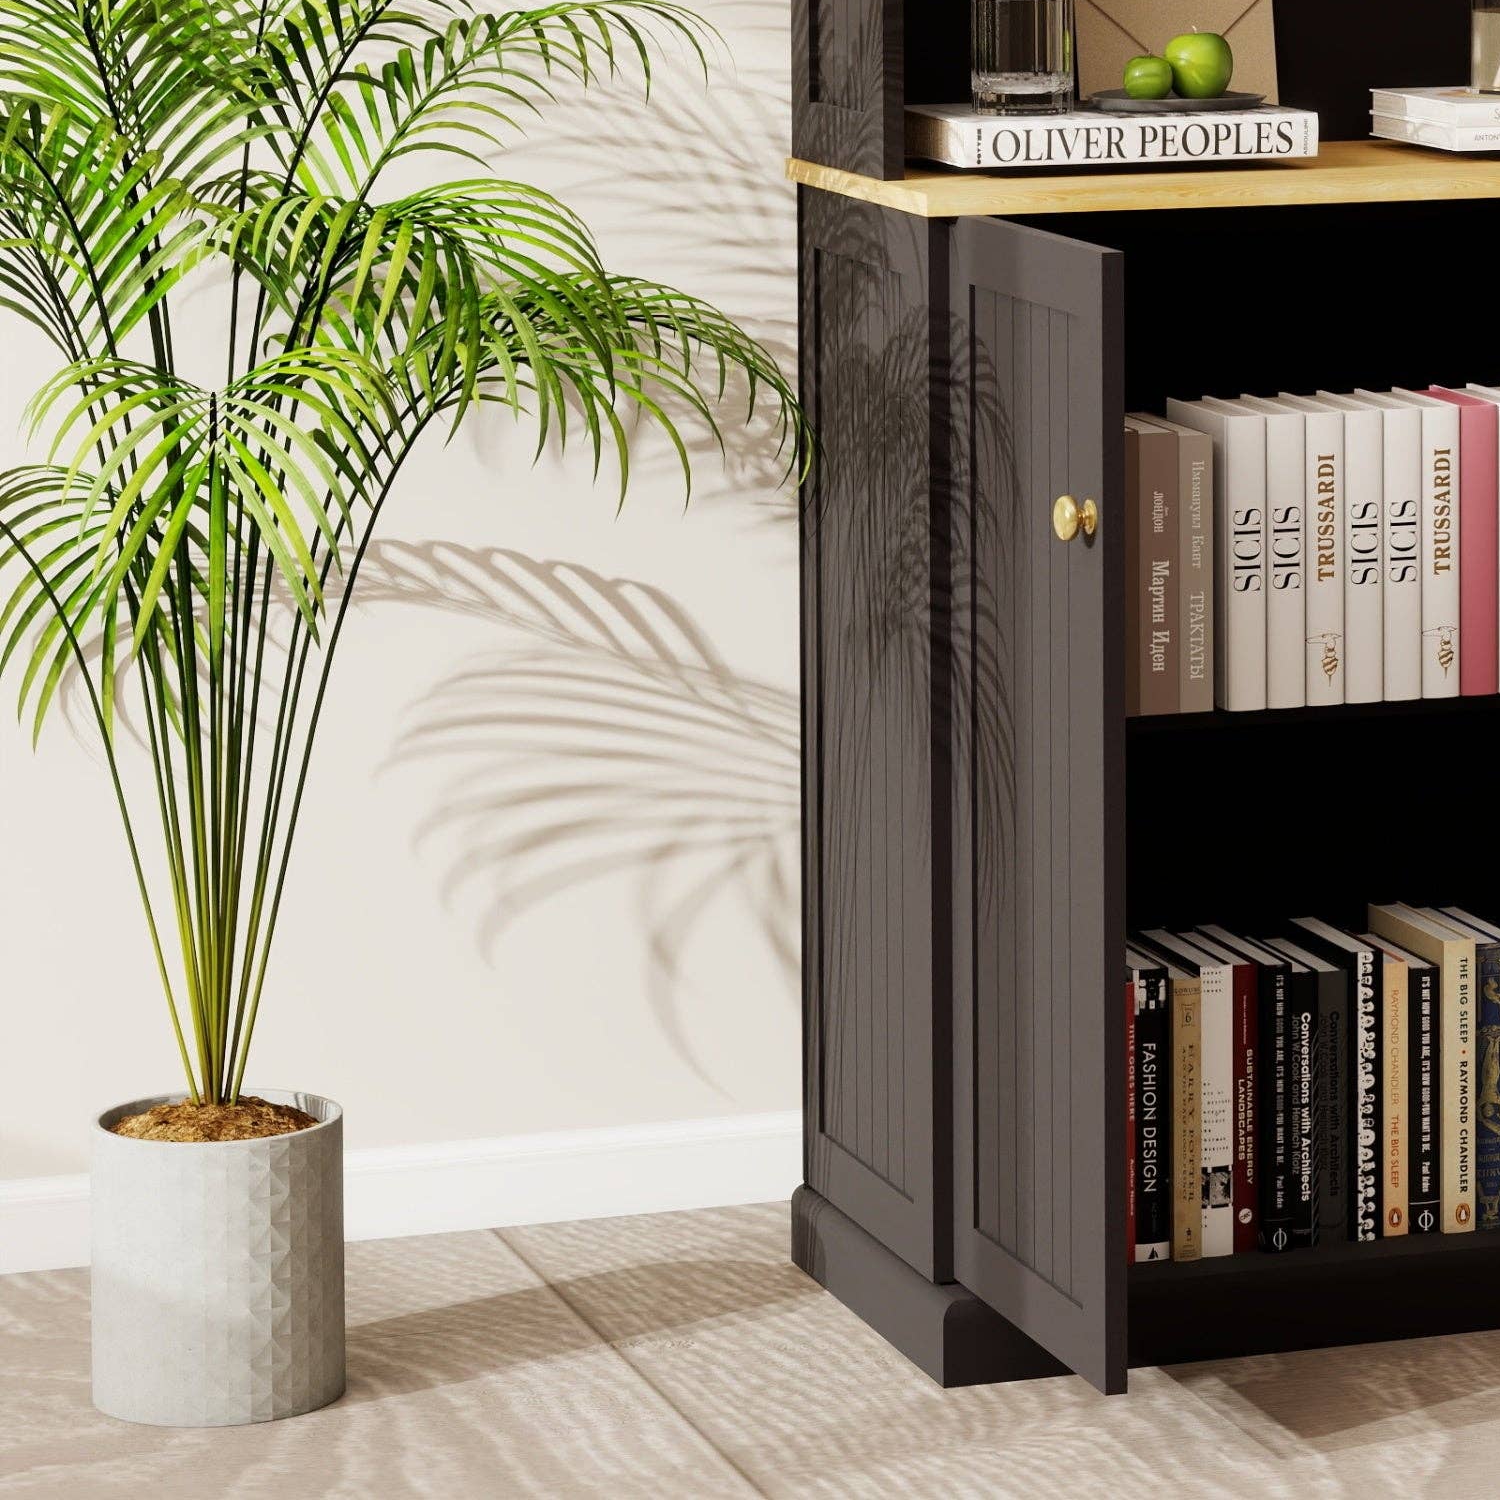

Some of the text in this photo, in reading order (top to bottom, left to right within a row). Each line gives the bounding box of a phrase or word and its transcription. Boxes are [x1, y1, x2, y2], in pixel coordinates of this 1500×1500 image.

[991, 120, 1295, 164] OLIVER PEOPLES
[1190, 460, 1205, 569] Иммануил Кант
[1233, 507, 1262, 592] SICIS
[1272, 505, 1301, 590] SICIS
[1317, 453, 1336, 582] TRUSSARDI
[1350, 501, 1379, 586] SICIS
[1388, 499, 1418, 584] SICIS
[1433, 448, 1451, 576] TRUSSARDI
[1148, 560, 1170, 672] Мартин Иден
[1189, 590, 1206, 681] ТРАКТАТЫ
[1184, 1011, 1192, 1024] 6
[1291, 1014, 1300, 1040] John
[1142, 1042, 1157, 1193] FASHION DESIGN
[1245, 1048, 1254, 1132] SUSTAINABLE
[1291, 1083, 1300, 1107] and
[1300, 1011, 1311, 1202] Conversations with Architects
[1390, 988, 1400, 1189] RAYMOND CHANDLER THE BIG SLEEP
[1459, 957, 1469, 1194] THE BIG SLEEP RAYMOND CHANDLER
[1237, 1078, 1246, 1161] LANDSCAPES
[1245, 1135, 1254, 1185] ENERGY
